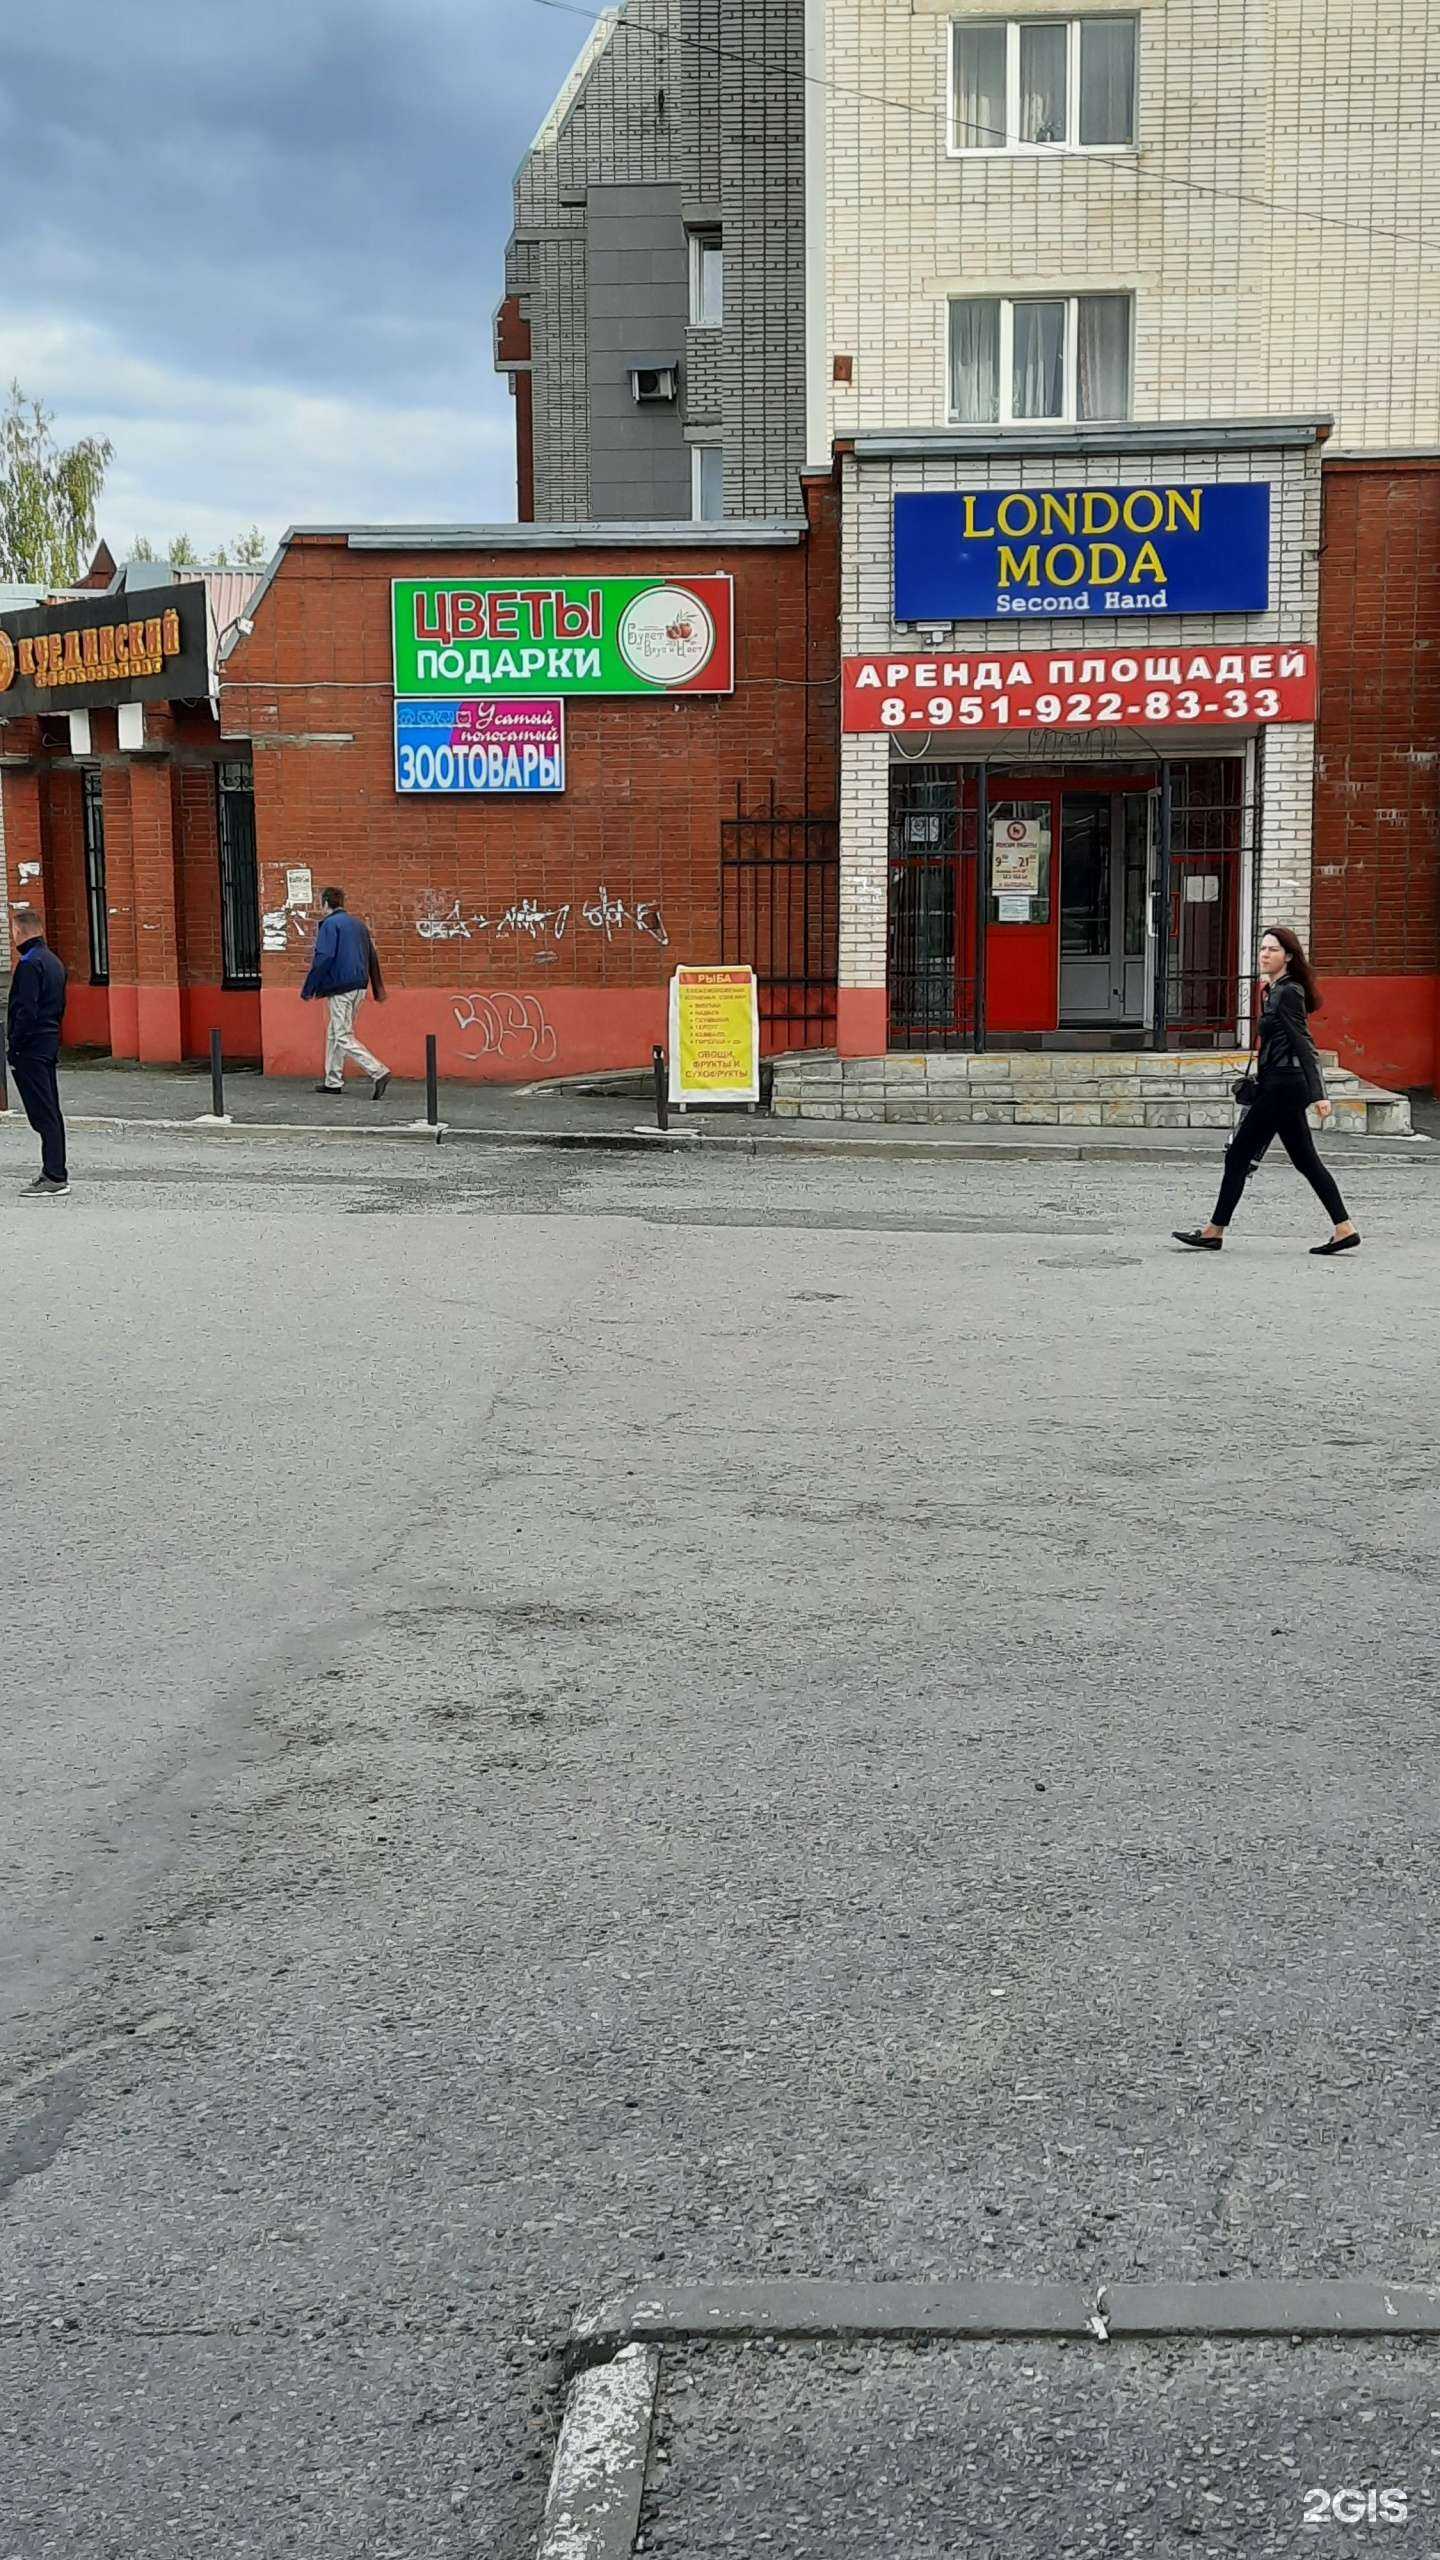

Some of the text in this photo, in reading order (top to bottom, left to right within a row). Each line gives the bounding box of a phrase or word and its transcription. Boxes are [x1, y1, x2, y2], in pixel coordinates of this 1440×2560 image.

[962, 489, 1203, 538] LONDON
[997, 541, 1168, 587] MODA
[413, 590, 602, 646] ЦВЕТЫ
[996, 589, 1168, 612] Second Hand
[18, 607, 180, 675] КУЕДИНСКИЙ
[417, 648, 602, 683] ПОДАРКИ
[855, 649, 1307, 691] АРЕНДА ПЛОЩАДЕЙ
[476, 702, 554, 729] Усатый
[880, 689, 1281, 726] 8-951-922-83-33
[461, 726, 559, 741] полосатый
[400, 744, 560, 788] ЗООТОВАРЫ
[697, 974, 732, 983] РЫБА
